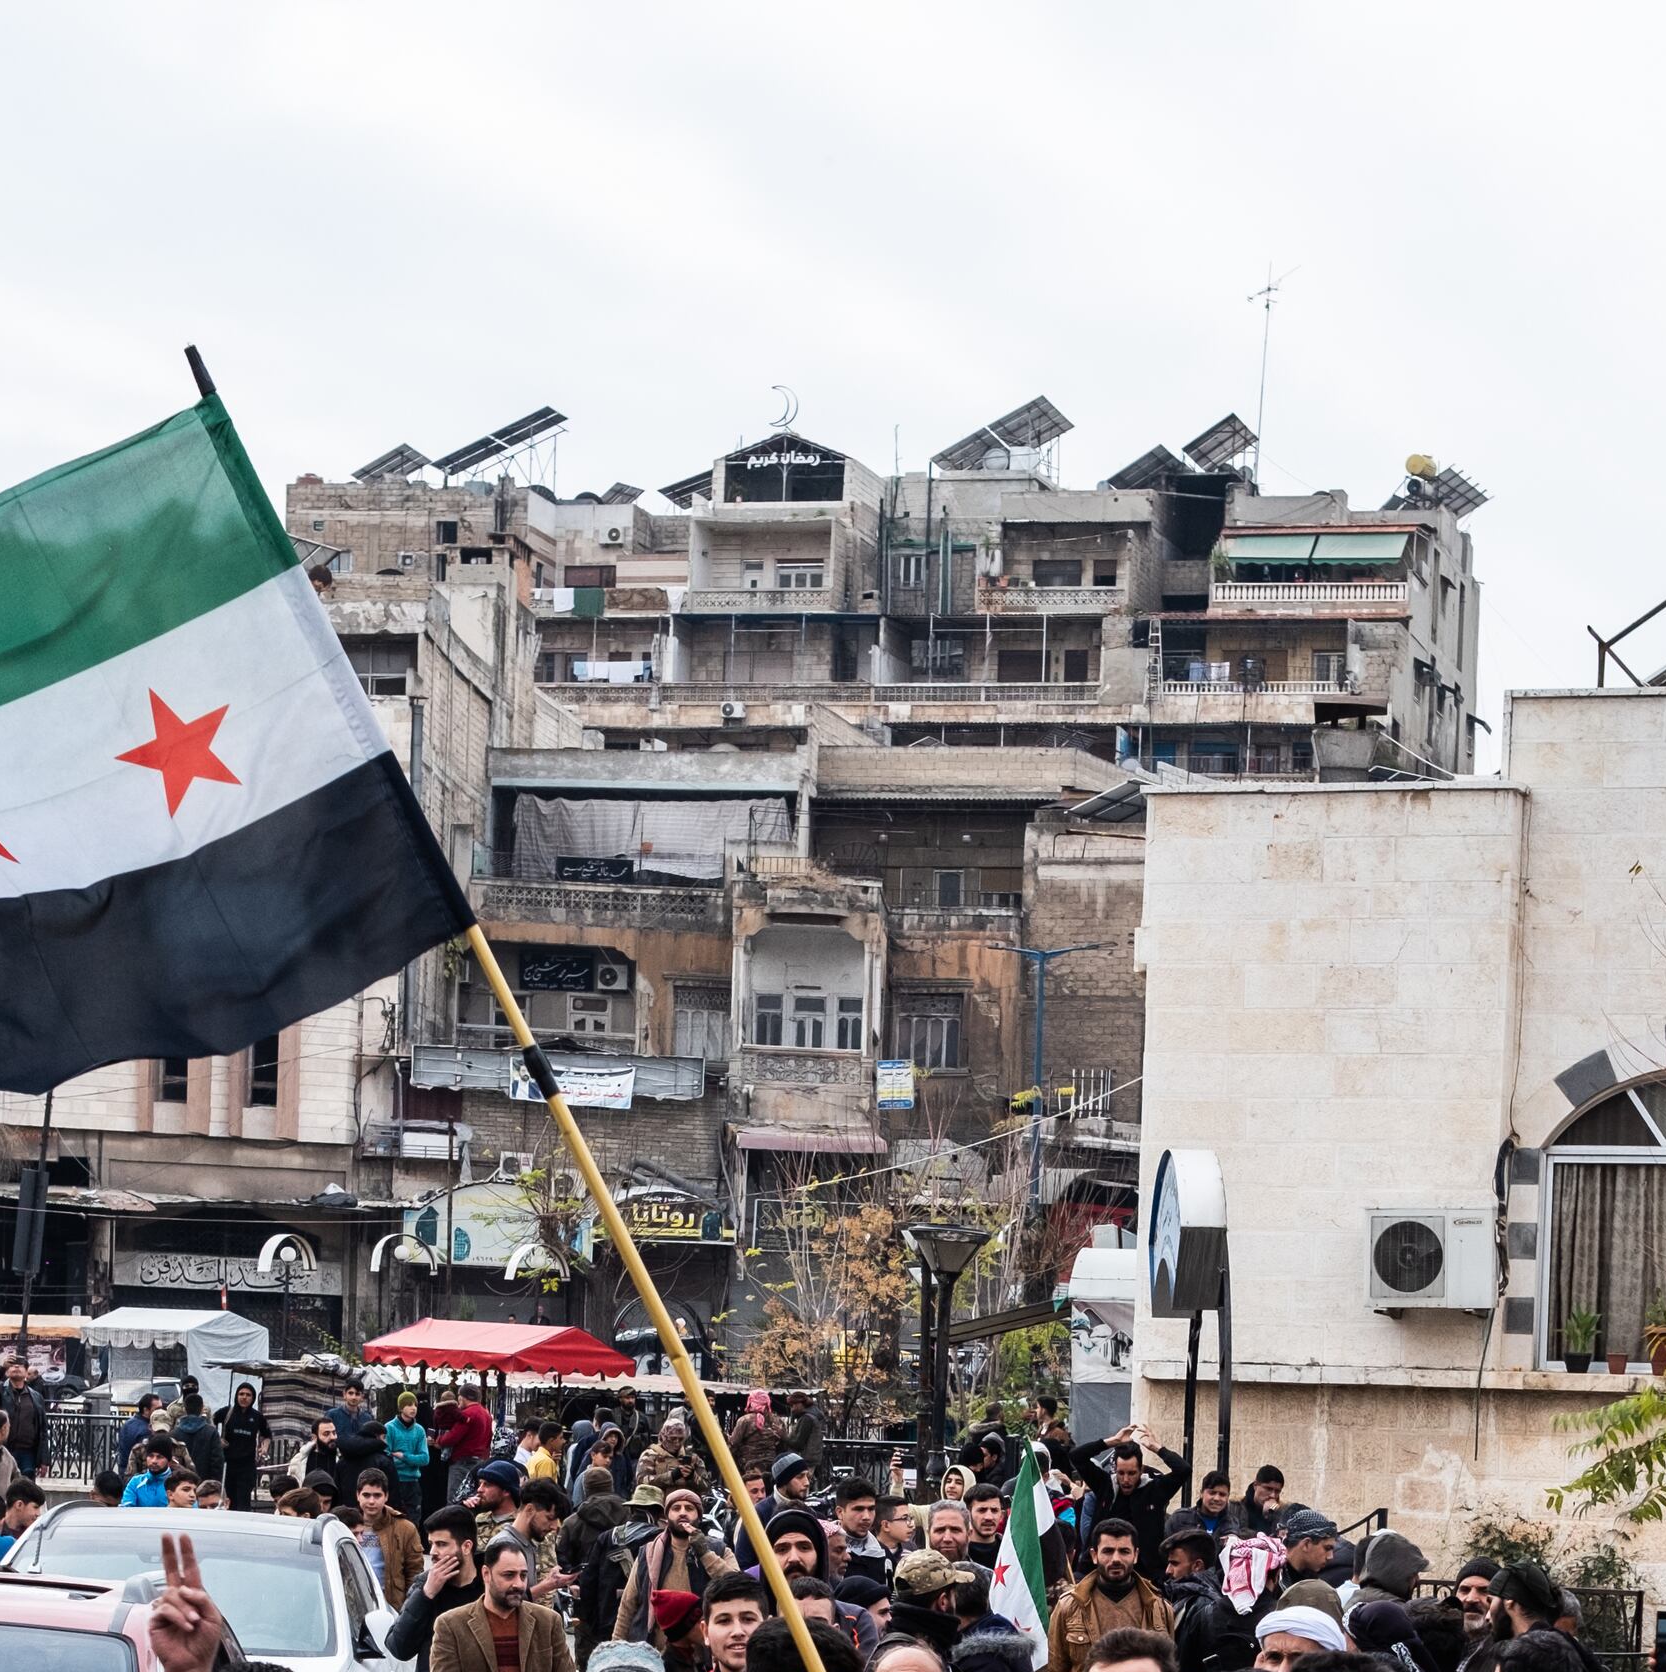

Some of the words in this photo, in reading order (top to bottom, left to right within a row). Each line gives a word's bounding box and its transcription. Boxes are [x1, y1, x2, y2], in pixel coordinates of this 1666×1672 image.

[746, 451, 779, 470] كريم
[780, 450, 820, 467] رمضان
[632, 1202, 696, 1228] روتانا
